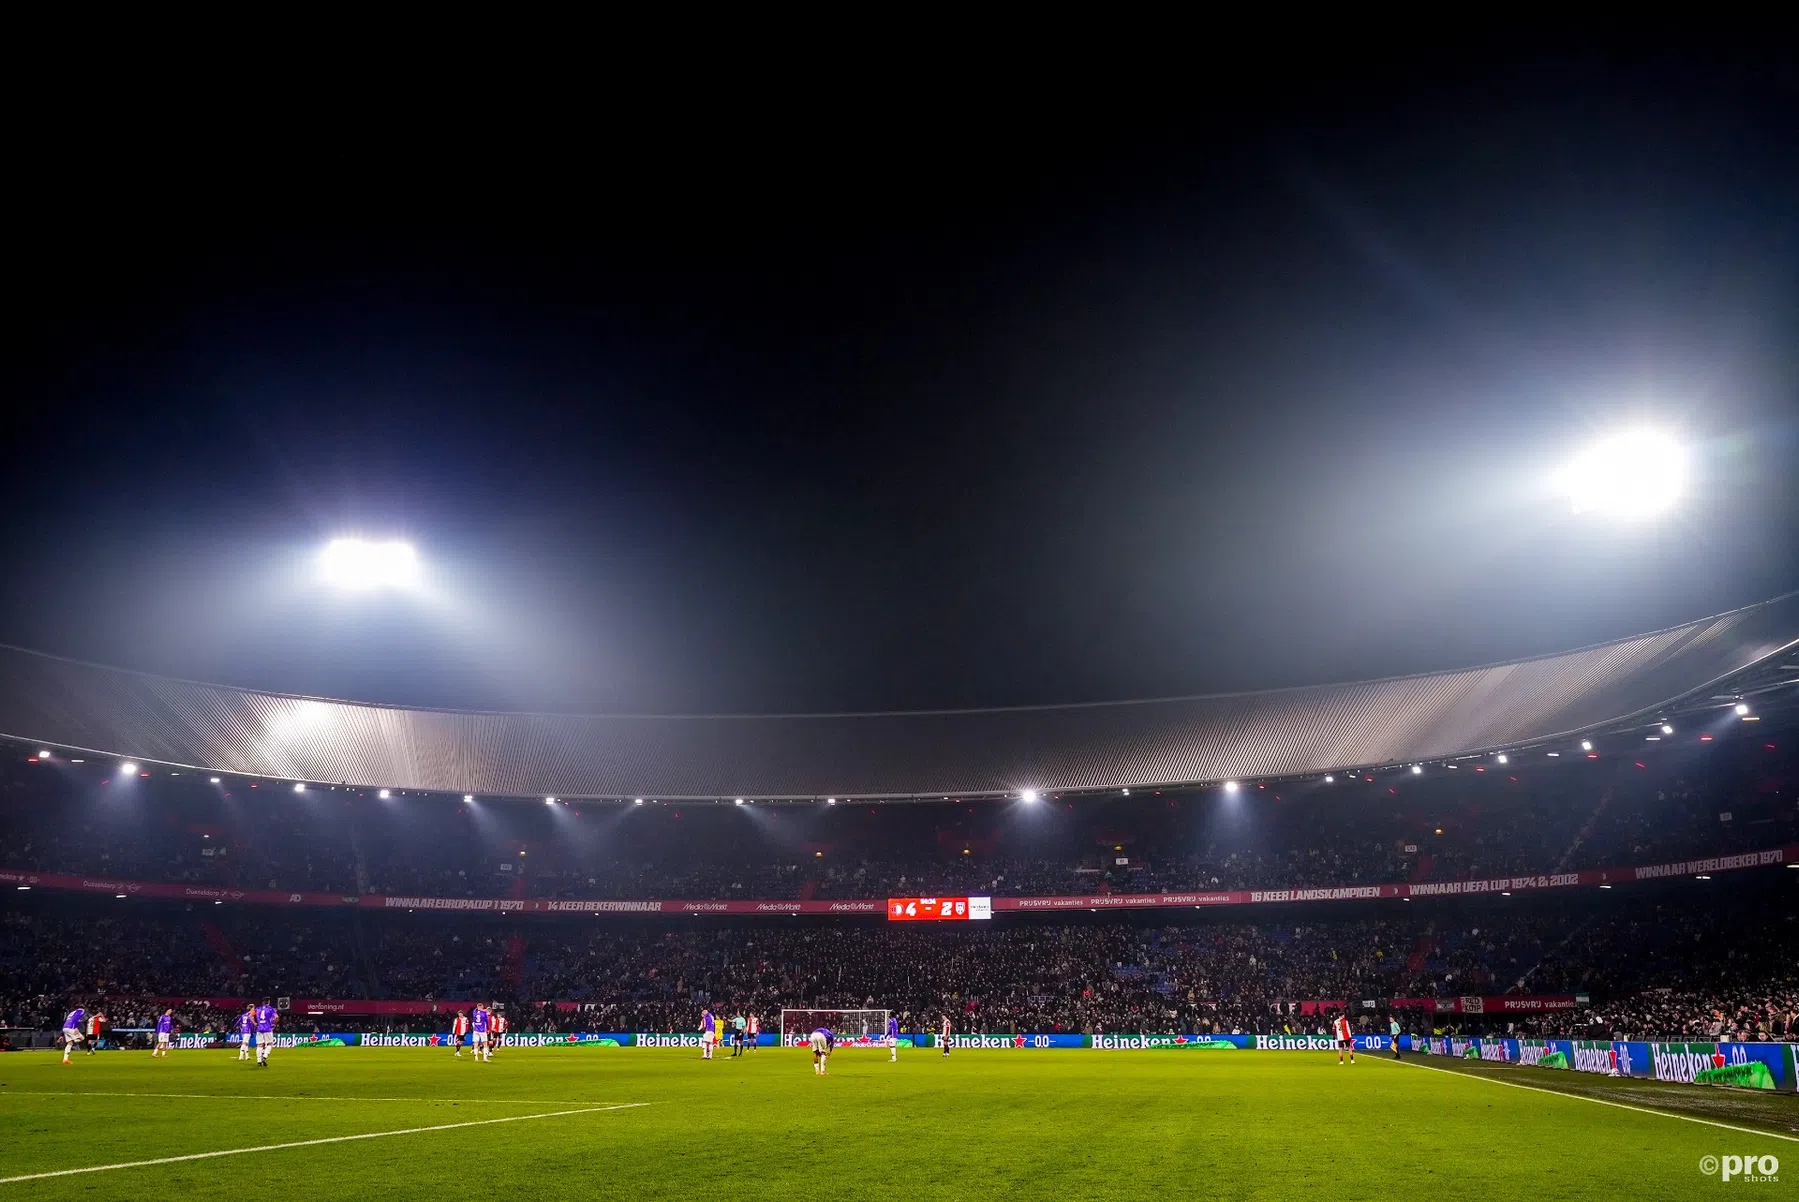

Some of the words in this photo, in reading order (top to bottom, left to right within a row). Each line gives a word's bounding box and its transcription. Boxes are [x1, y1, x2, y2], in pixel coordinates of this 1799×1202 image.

[1635, 862, 1686, 879] WINNAAR
[1687, 853, 1758, 875] WERELDBEKER
[1759, 849, 1783, 866] 1970
[1409, 881, 1461, 895] WINNAAR
[1463, 880, 1489, 893] UEFA
[1490, 879, 1510, 892] CUP
[1510, 877, 1536, 889] 1974
[1550, 874, 1578, 886] 2002
[289, 894, 302, 902] AD
[1251, 892, 1263, 902] 16
[1263, 890, 1289, 901] KEER
[1290, 887, 1380, 901] LANDSKAMPIOEN
[385, 897, 434, 908] WINNAAR
[434, 898, 492, 910] EUROPACUP
[500, 900, 524, 910] 1970
[558, 901, 584, 911] KEER
[584, 901, 662, 912] BEKERWINNAAR
[905, 902, 916, 916] 4
[941, 902, 953, 916] 2
[1544, 999, 1577, 1008] vakantie
[273, 1034, 309, 1048] eineken
[361, 1034, 426, 1047] Heineken
[933, 1034, 1011, 1048] Heineken
[1091, 1035, 1170, 1049] Heineken
[1255, 1035, 1339, 1050] Heineken
[1572, 1040, 1612, 1074] Heineken
[1651, 1042, 1712, 1084] Heineken
